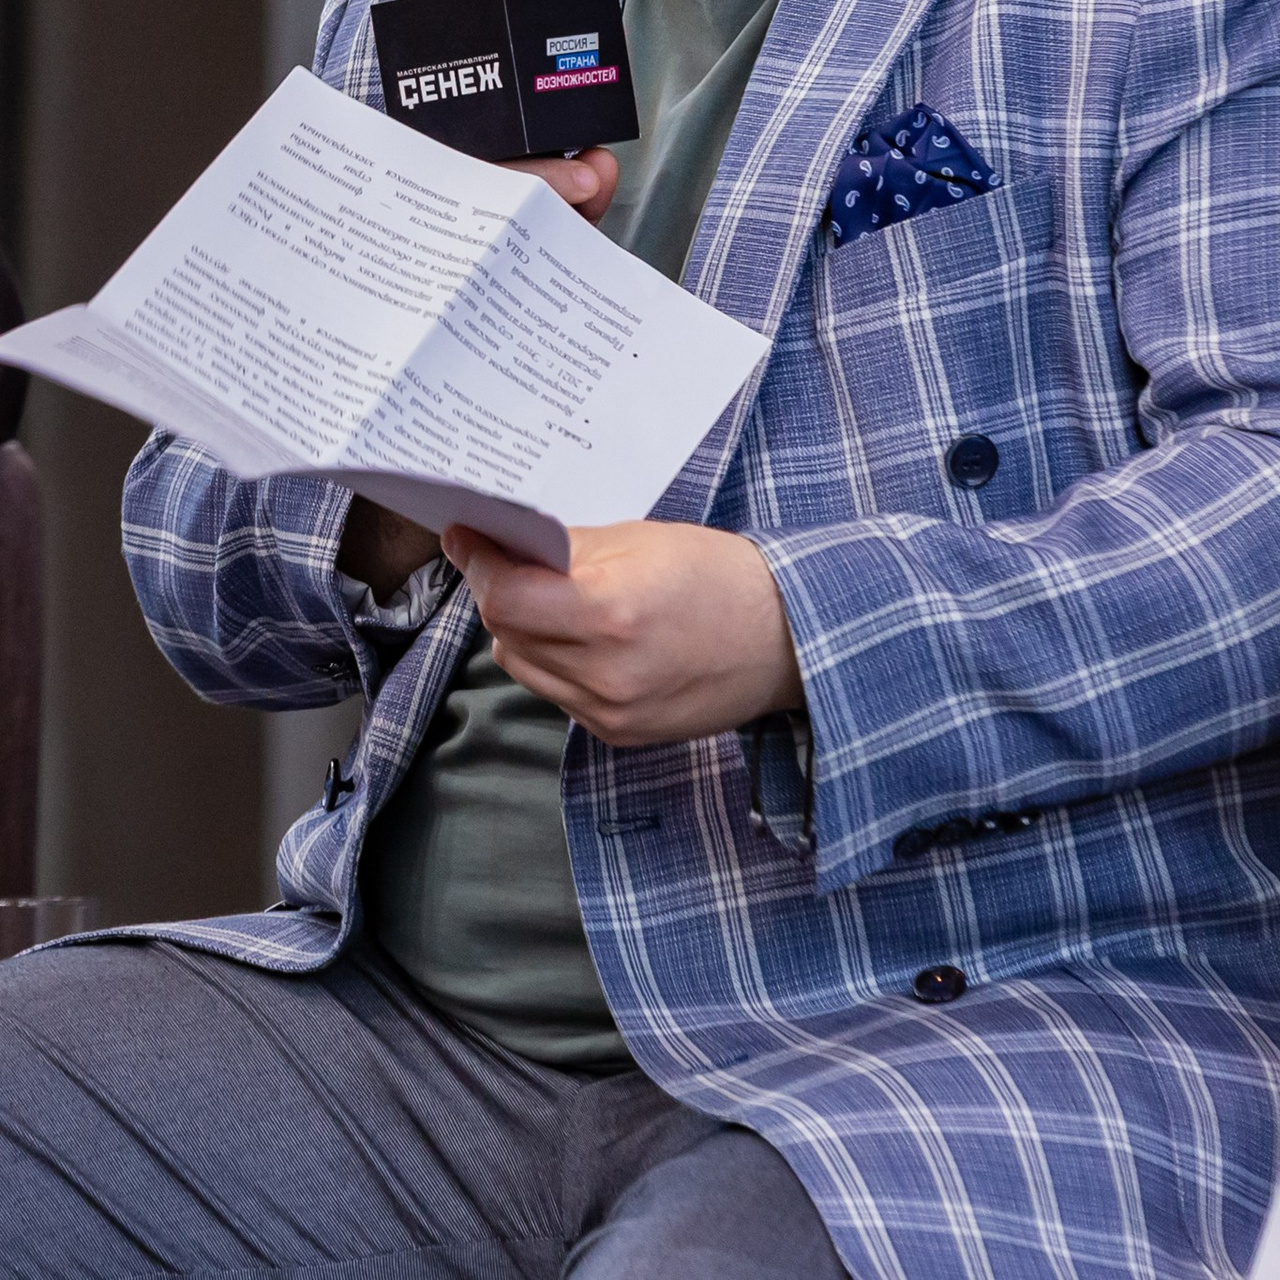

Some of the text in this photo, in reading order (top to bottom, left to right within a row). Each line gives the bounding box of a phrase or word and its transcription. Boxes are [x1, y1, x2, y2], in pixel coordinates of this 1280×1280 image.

[549, 37, 587, 53] РОССИЯ
[397, 53, 499, 77] МАСТЕРСКАЯ УПРАВЛЕНИЯ
[558, 56, 597, 69] СТРАНА
[536, 68, 616, 90] ВОЗМОЖНОСТЕЙ
[289, 132, 321, 155] якобы
[299, 122, 374, 167] электоральным
[280, 144, 363, 196] финансирование
[343, 164, 372, 183] стран
[385, 169, 460, 208] занимающихся
[238, 191, 273, 222] России
[248, 181, 315, 228] политическая
[395, 191, 458, 223] европейских
[260, 225, 288, 245] отказ
[304, 234, 346, 263] выборах
[319, 226, 336, 240] как
[341, 237, 354, 251] то,
[409, 216, 500, 255] ангажированности
[290, 244, 327, 269] служит
[412, 241, 490, 279] международных
[506, 237, 530, 265] США
[257, 170, 602, 380] предвзятость негативно сказывается на обеспечении транспарентности
[358, 249, 434, 286] демонстрирует
[359, 265, 433, 302] парламентских
[436, 283, 479, 312] наглядно
[489, 277, 523, 309] миссий
[511, 265, 568, 314] финансовой
[538, 246, 642, 325] неправительственных
[443, 300, 456, 313] на
[523, 307, 560, 334] работе
[549, 277, 634, 337] правительствами
[423, 310, 487, 360] политической
[463, 319, 500, 351] миссию
[480, 311, 514, 341] случай
[583, 321, 625, 352] Пример
[516, 340, 541, 363] Этот
[567, 337, 611, 368] выборов
[488, 358, 539, 396] примером
[513, 356, 586, 405] разворачивать
[557, 368, 583, 389] 2021
[540, 393, 575, 418] Ярким
